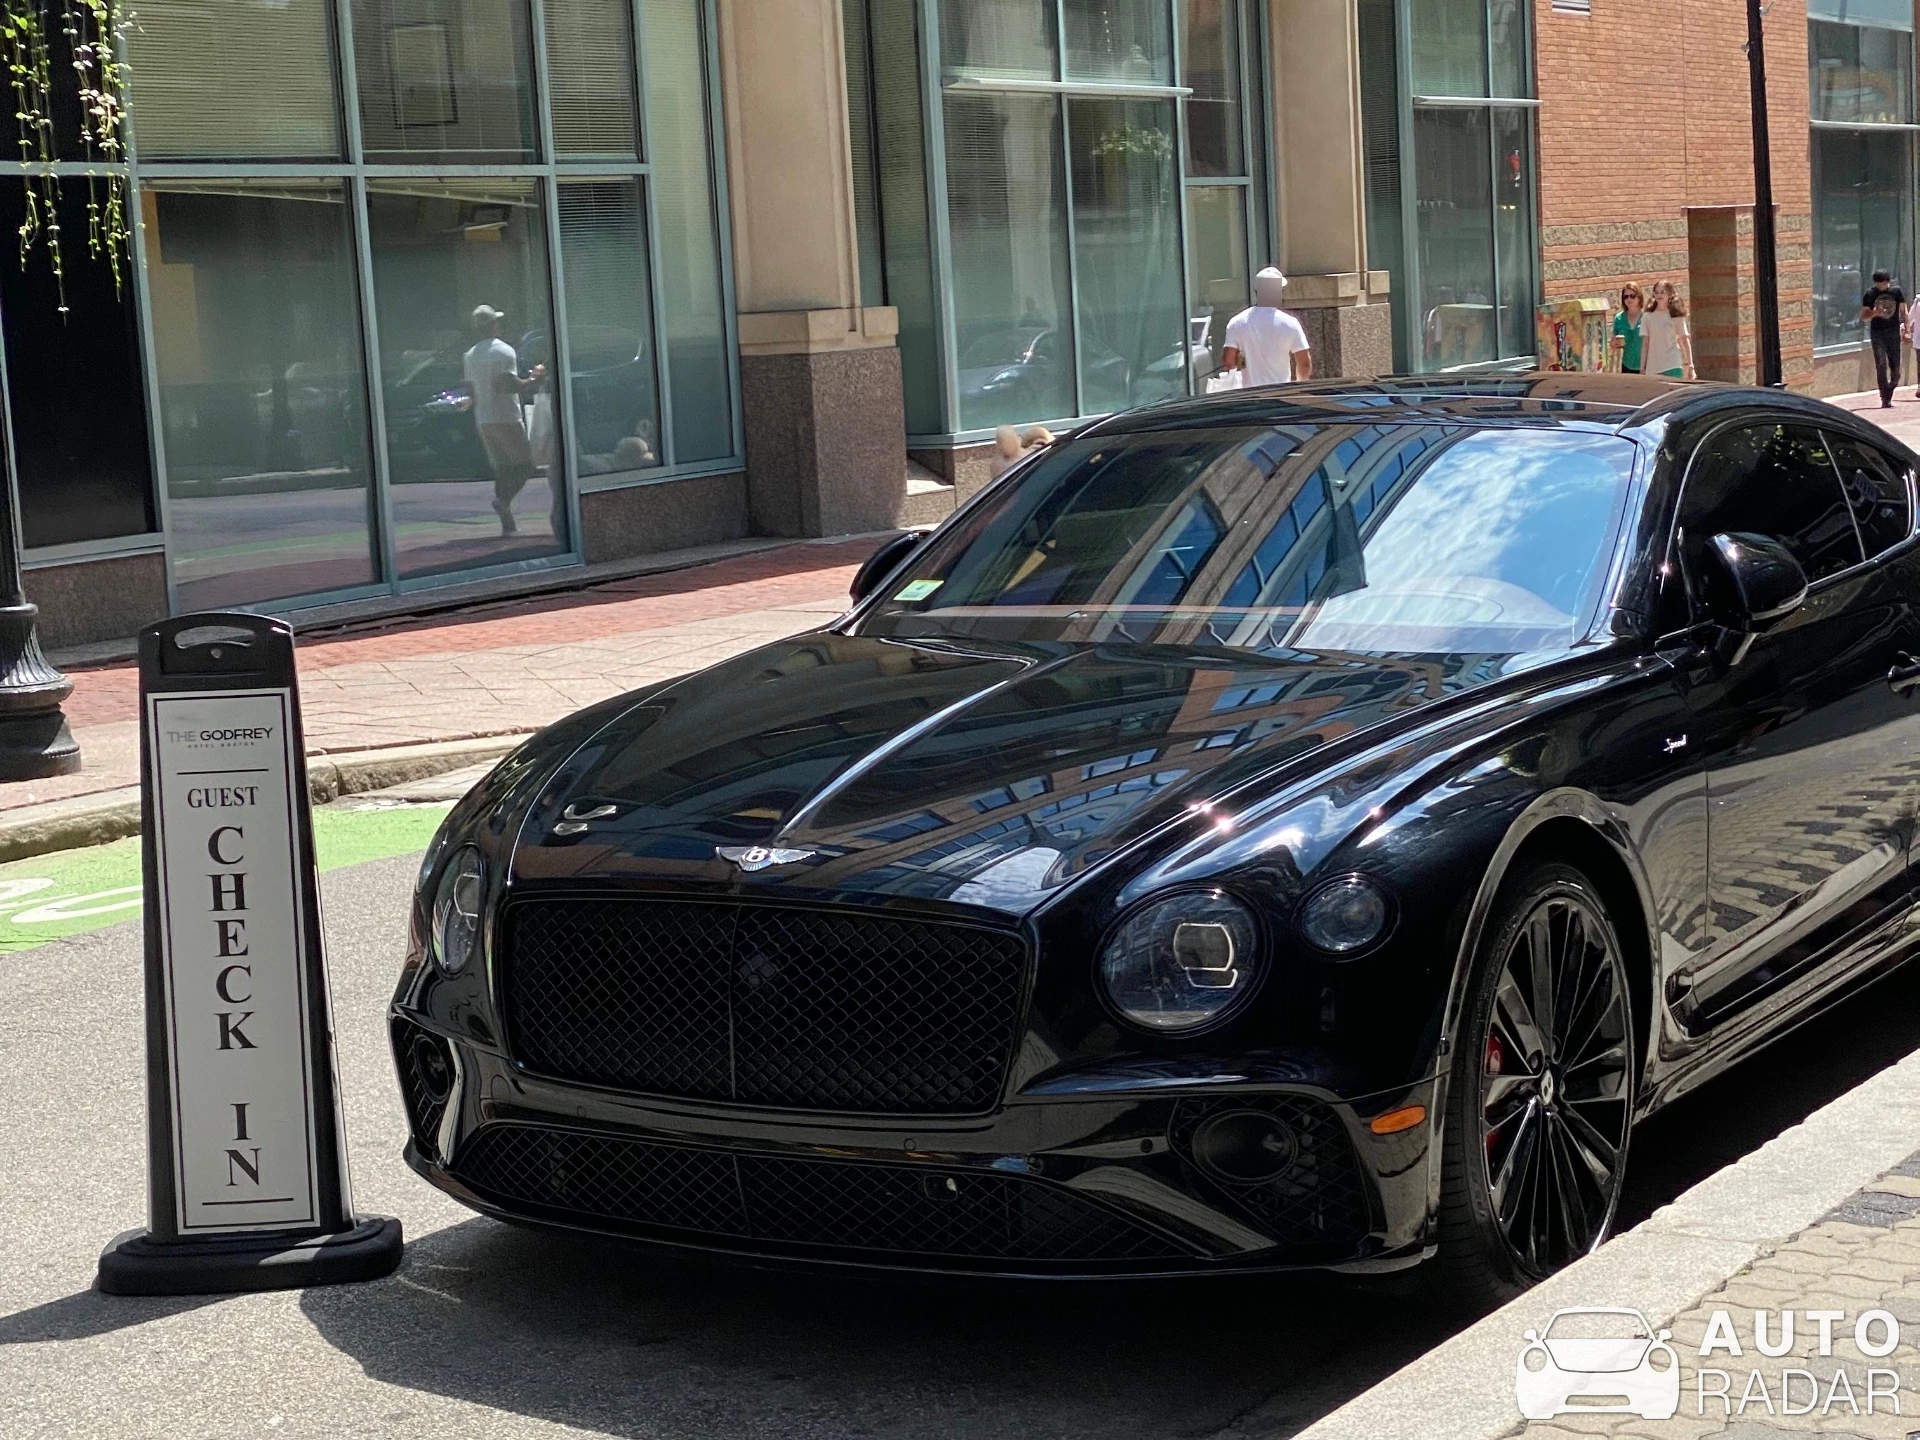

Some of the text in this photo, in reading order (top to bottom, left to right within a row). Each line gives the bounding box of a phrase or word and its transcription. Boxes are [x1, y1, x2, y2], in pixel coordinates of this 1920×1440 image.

[166, 727, 273, 742] THE GODFREY
[187, 786, 258, 808] GUEST
[207, 826, 262, 1187] CHECK IN
